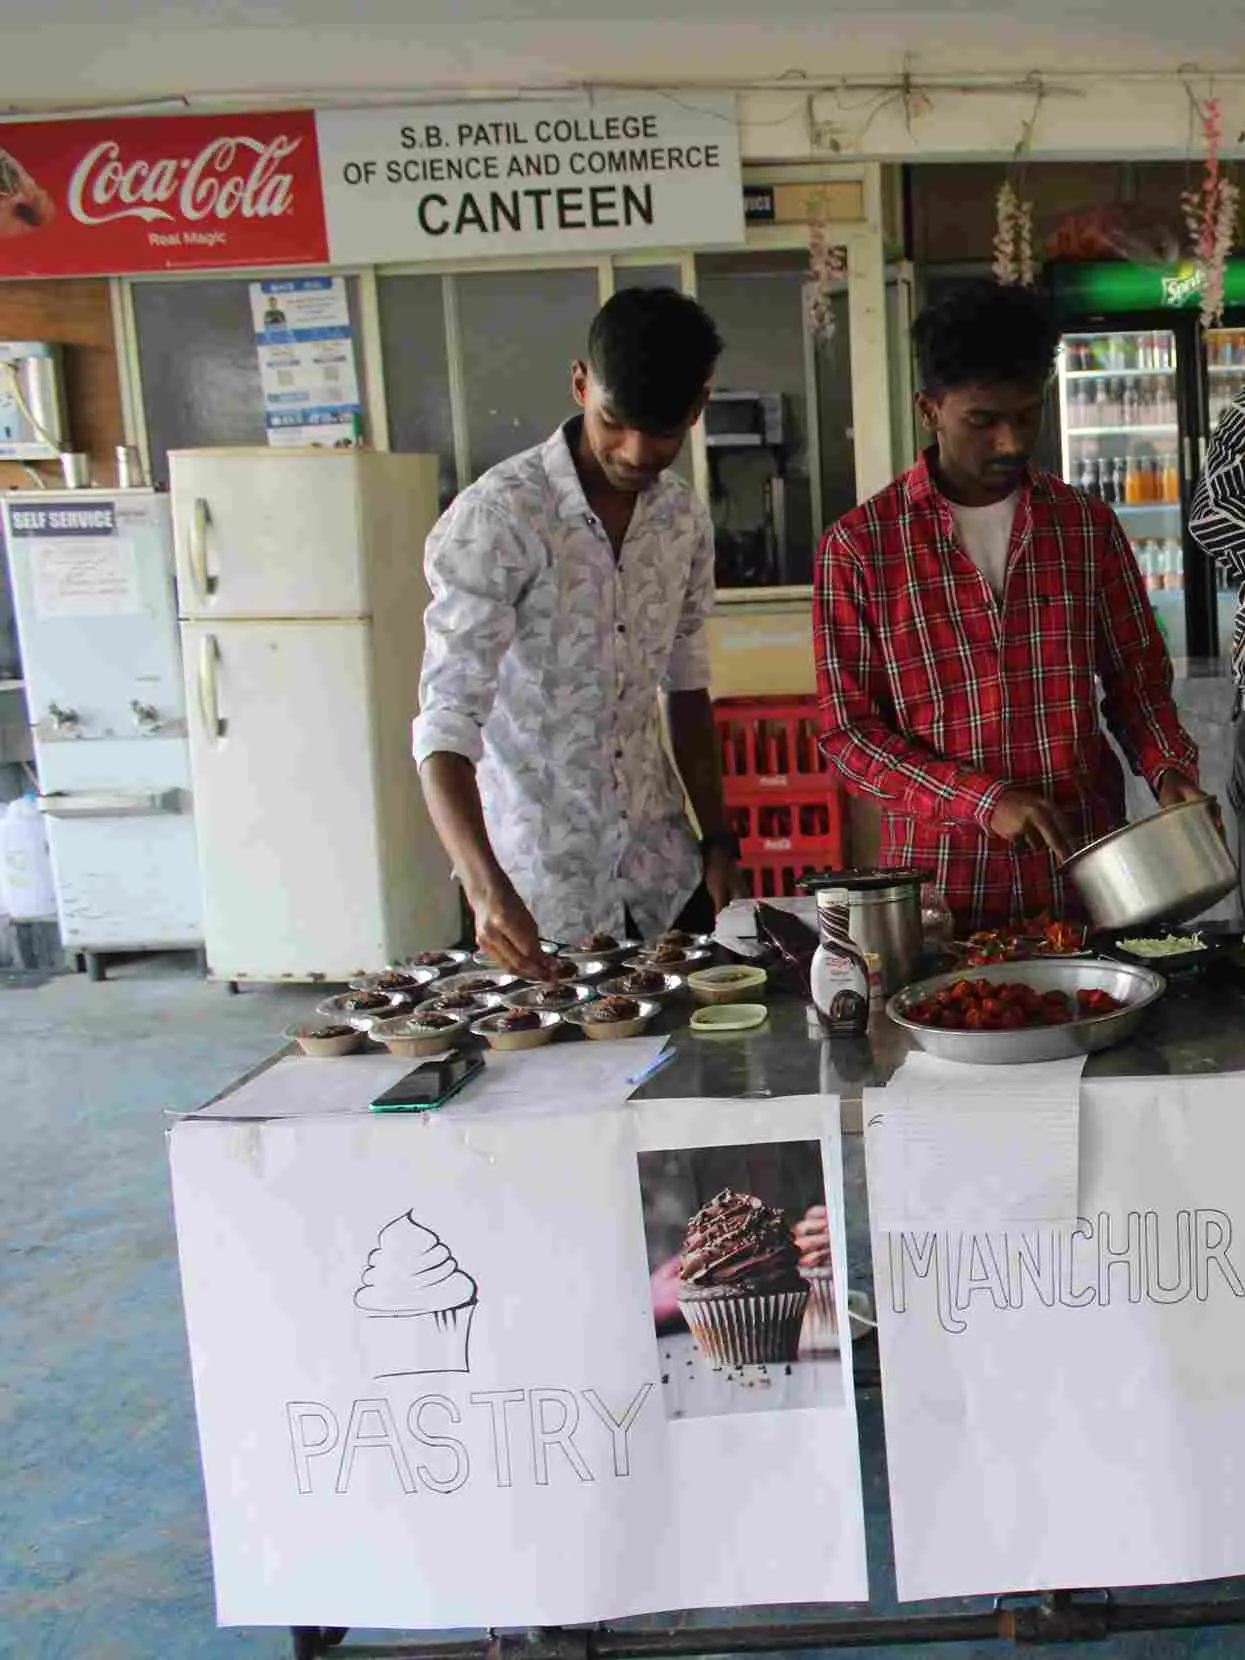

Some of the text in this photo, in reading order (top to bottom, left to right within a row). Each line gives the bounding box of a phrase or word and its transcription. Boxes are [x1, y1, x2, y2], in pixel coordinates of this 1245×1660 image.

[401, 116, 658, 149] S.B. PATIL COLLEGE
[343, 145, 720, 185] OF SCIENCE AND COMMERCE
[418, 184, 654, 236] CANTEEN
[148, 232, 182, 246] Real
[13, 509, 113, 529] SELF SERVICE
[286, 1382, 656, 1494] PASTRY
